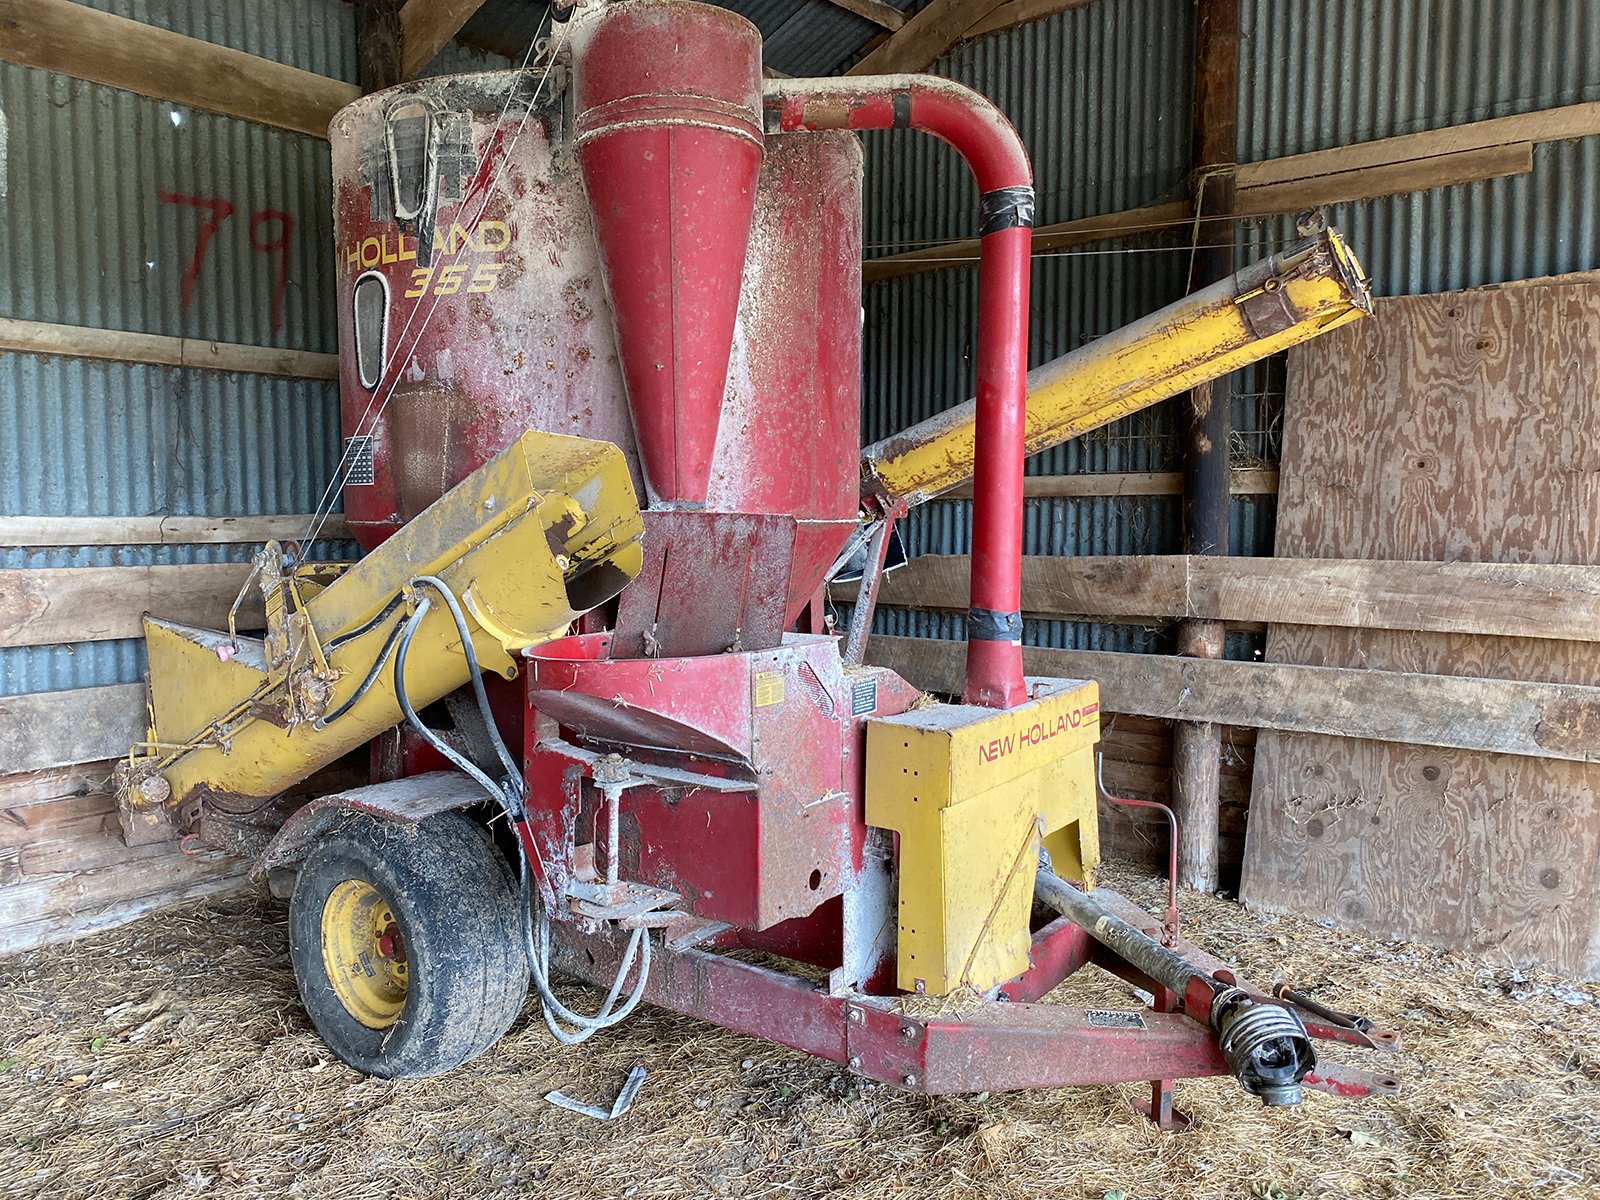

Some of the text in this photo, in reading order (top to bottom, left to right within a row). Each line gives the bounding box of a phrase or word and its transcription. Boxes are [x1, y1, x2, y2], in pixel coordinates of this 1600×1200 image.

[159, 188, 292, 332] 79
[405, 263, 503, 299] 355
[979, 709, 1081, 766] NEW HOLLAND
